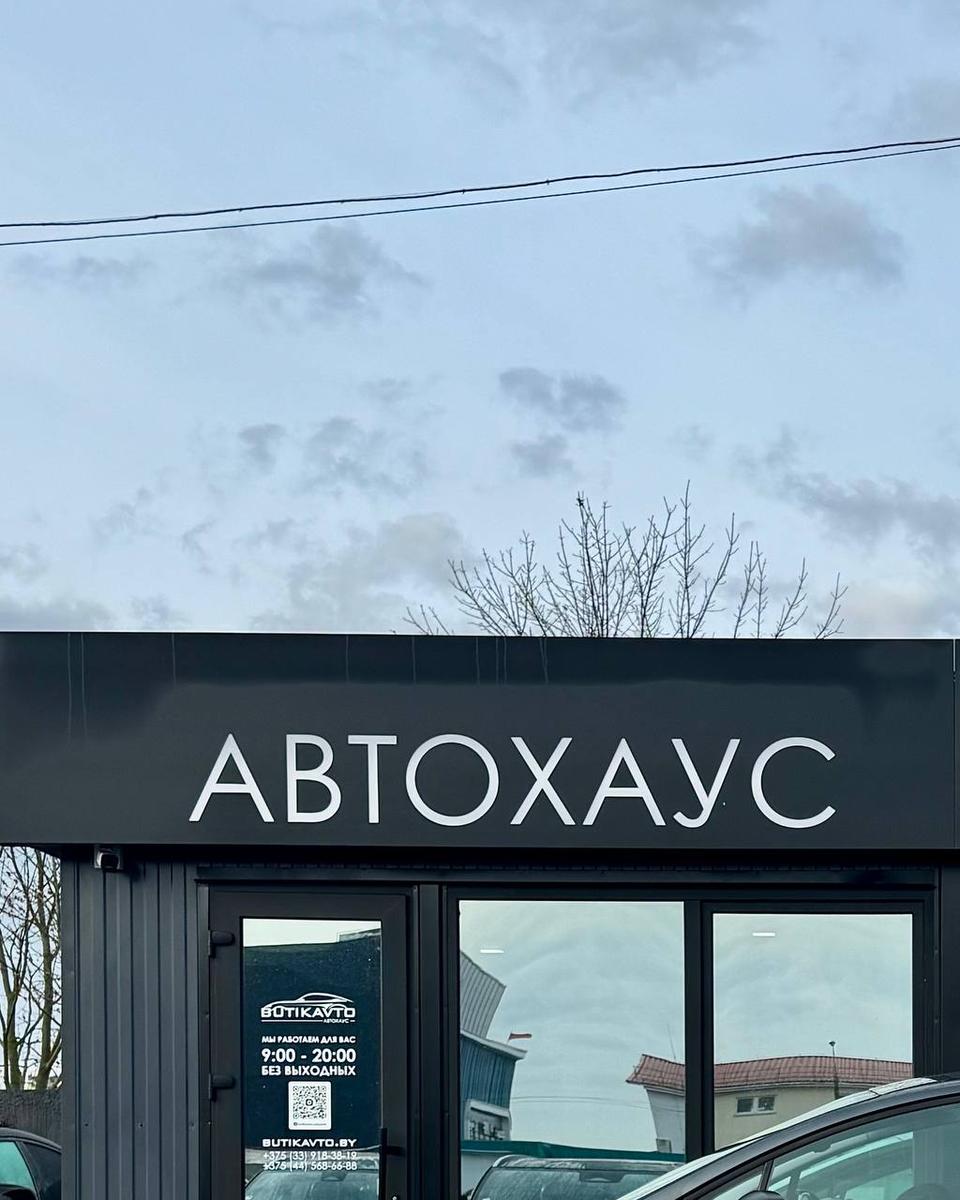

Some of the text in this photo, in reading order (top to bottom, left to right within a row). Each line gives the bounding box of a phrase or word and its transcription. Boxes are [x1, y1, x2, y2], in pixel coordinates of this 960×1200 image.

[188, 733, 837, 829] АВТОХАУС
[261, 1007, 356, 1018] BUTIKAVTO
[320, 1036, 338, 1044] ДЛЯ
[261, 1048, 296, 1063] 9:00
[311, 1048, 357, 1063] 20:00
[261, 1065, 357, 1077] БЕЗ ВЫХОДНЫХ
[262, 1138, 358, 1147] BUTIKAVTO.BY
[263, 1150, 358, 1162] +375 (33) 918-38-19
[289, 1160, 307, 1172] (44)
[310, 1161, 358, 1171] 568-66-88
